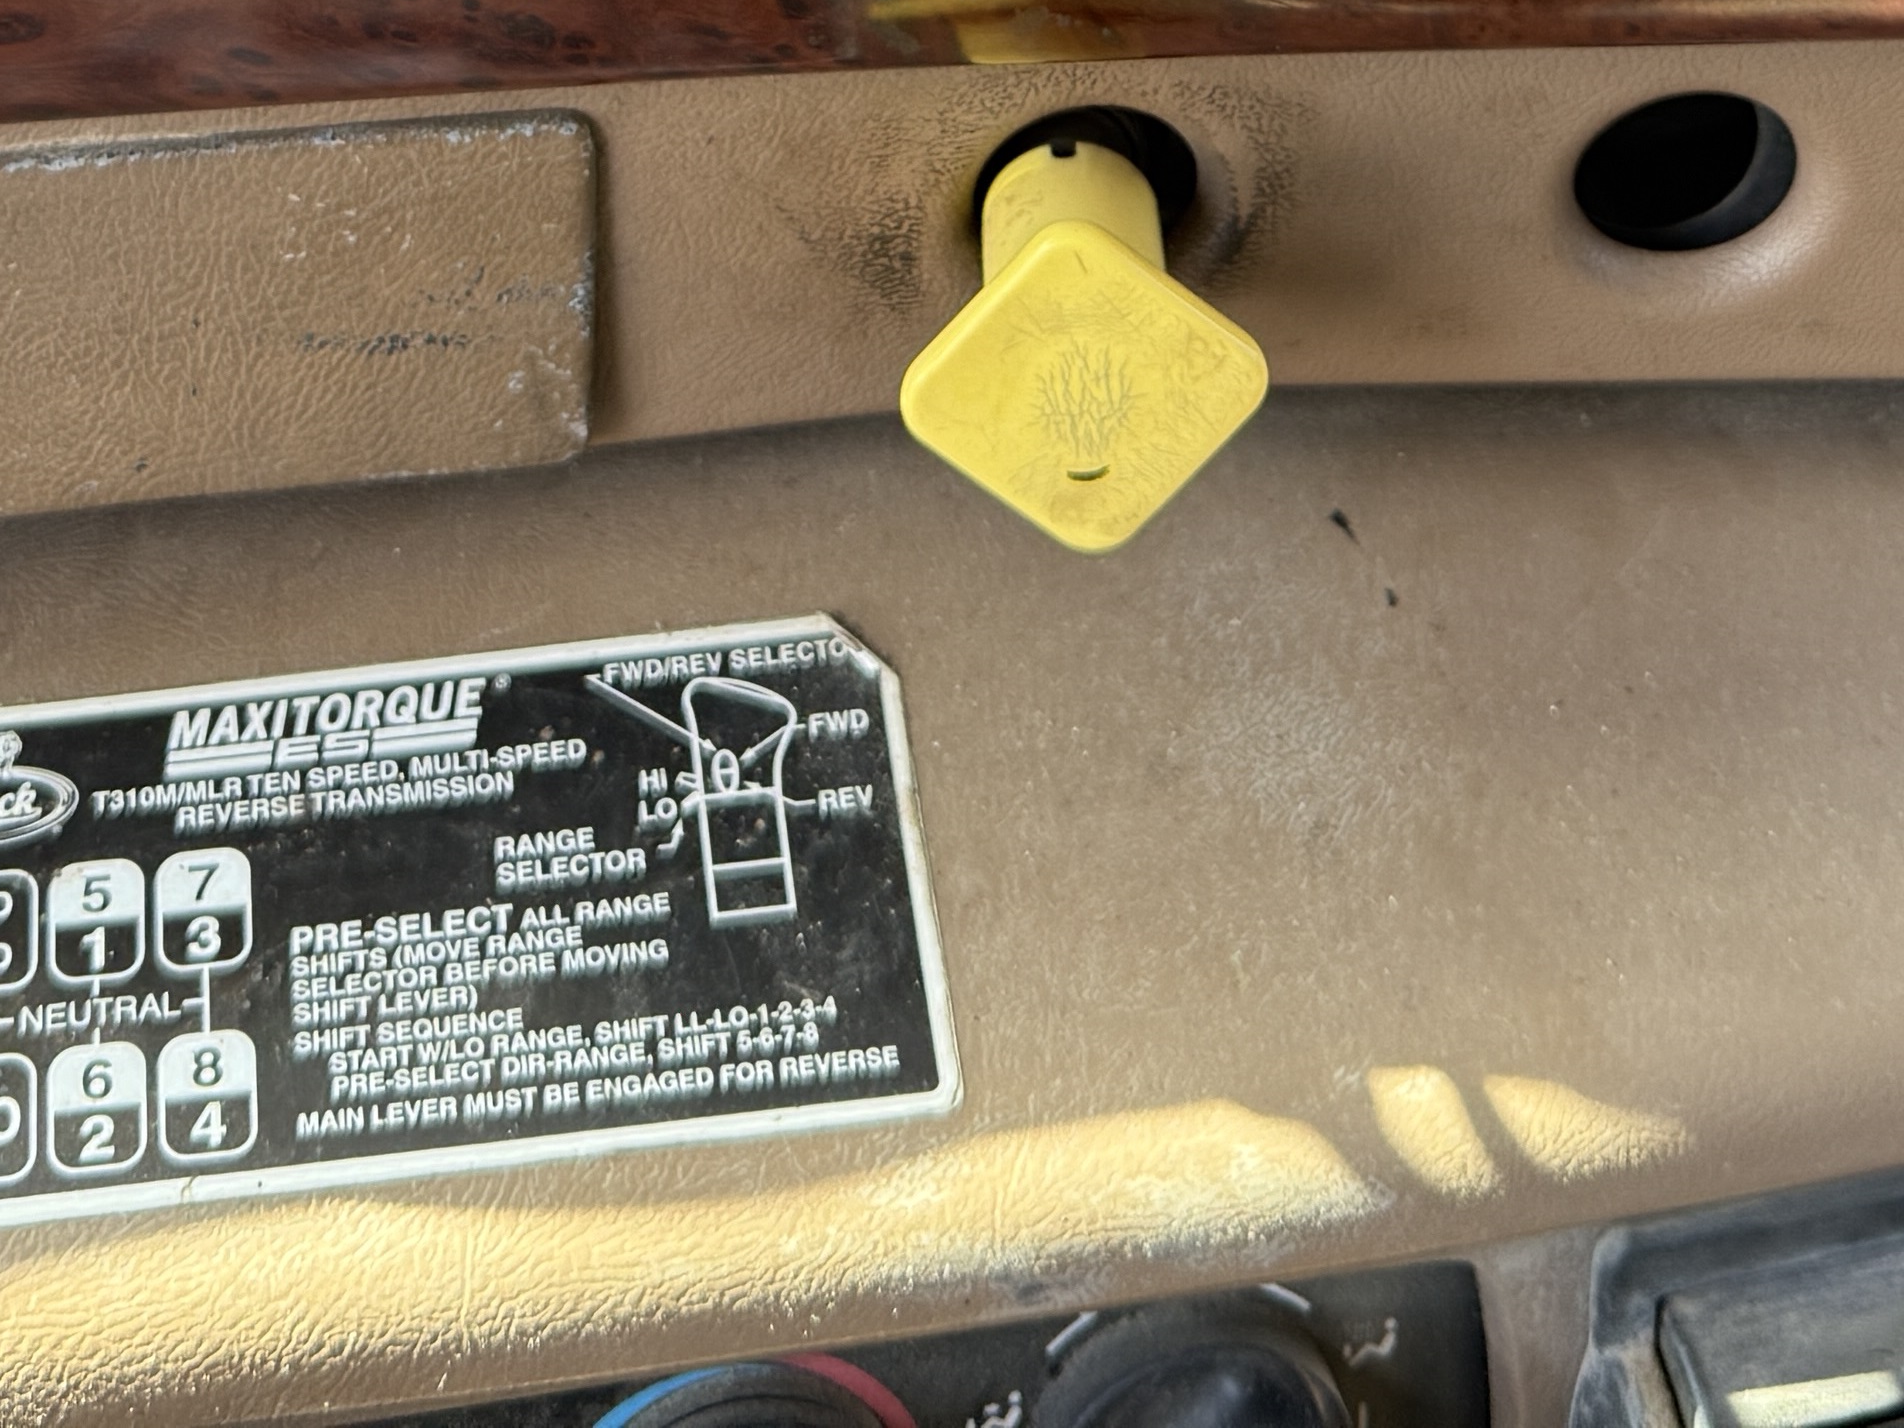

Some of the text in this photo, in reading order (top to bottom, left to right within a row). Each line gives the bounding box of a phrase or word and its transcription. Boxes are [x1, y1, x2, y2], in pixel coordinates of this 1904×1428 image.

[602, 651, 722, 690] FWD/REV
[808, 708, 870, 742] FWD
[247, 770, 301, 800] TEN
[408, 738, 587, 781] MULTI-SPEED
[638, 768, 668, 797] HI
[174, 771, 514, 834] REVERSE TRANSMISSION
[638, 797, 678, 832] LO
[817, 784, 873, 821] REV
[495, 826, 596, 861] RANGE
[188, 863, 221, 901] 7
[496, 847, 647, 894] SELECTOR
[82, 874, 114, 913] 5
[185, 916, 222, 959] 3
[290, 892, 671, 955] PRE-SELECT ALL RANGE
[82, 926, 107, 972] 1
[291, 926, 583, 977] SHIFTS (MOVE RANGE
[292, 939, 669, 1000] SELECTOR BEFORE MOVING
[16, 992, 182, 1035] NEUTRAL
[292, 984, 477, 1025] SHIFT LEVER)
[293, 1008, 523, 1058] SHIFT SEQUENCE
[329, 1045, 413, 1074] START
[418, 1037, 484, 1066] W/LO
[596, 1015, 669, 1041] SHIFT
[82, 1060, 113, 1097] 6
[193, 1047, 224, 1086] 8
[331, 1059, 496, 1101] PRE-SELECT
[658, 1032, 731, 1066] SHIFT
[736, 1021, 819, 1059] 5-6-7-8
[297, 1045, 900, 1139] MAIN LEVER MUST BE ENGAGED FOR REVERSE
[79, 1114, 115, 1162] 2
[191, 1102, 225, 1147] 4
